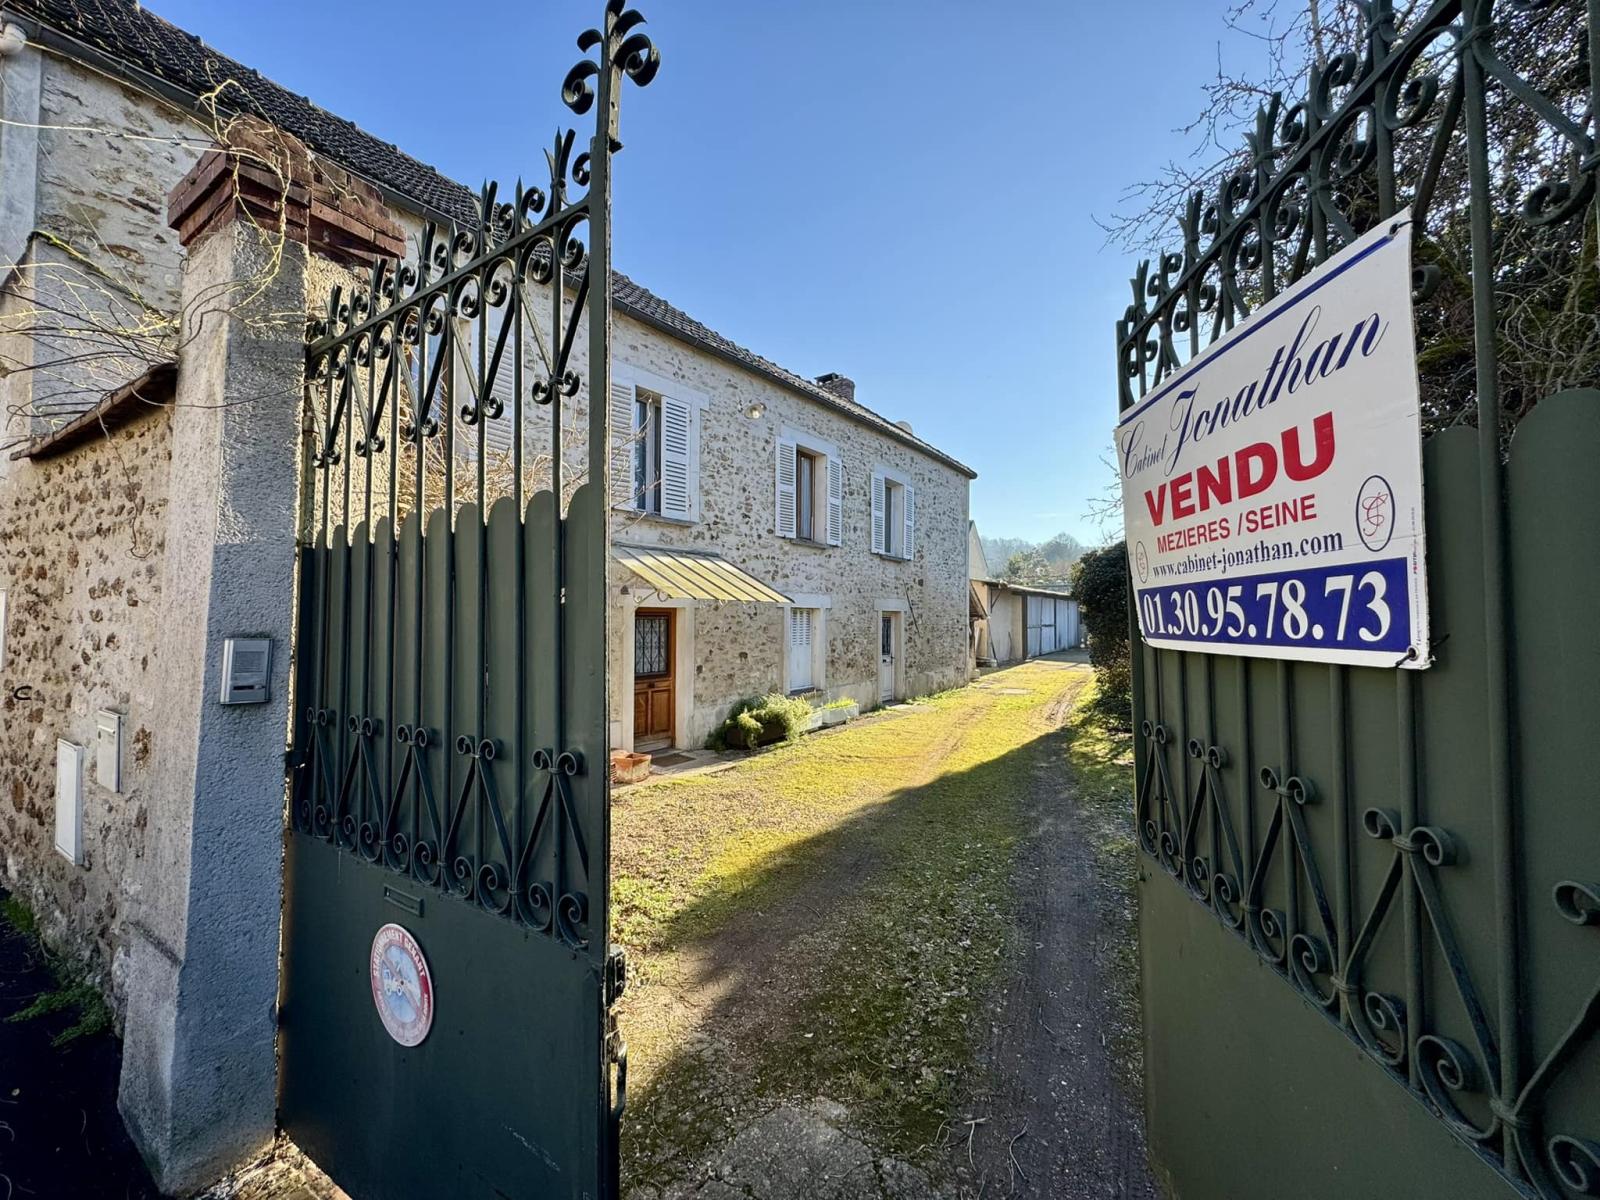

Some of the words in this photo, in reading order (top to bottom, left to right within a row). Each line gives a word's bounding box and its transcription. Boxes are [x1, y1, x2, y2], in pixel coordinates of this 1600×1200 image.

[1122, 421, 1168, 478] Cabinet
[1166, 304, 1390, 477] Jonathan
[1144, 411, 1336, 527] VENDU
[1153, 532, 1343, 576] www.cabinet-jonathan.com
[1157, 518, 1230, 553] MEZIERES
[1143, 571, 1391, 642] 01.30.95.78.73
